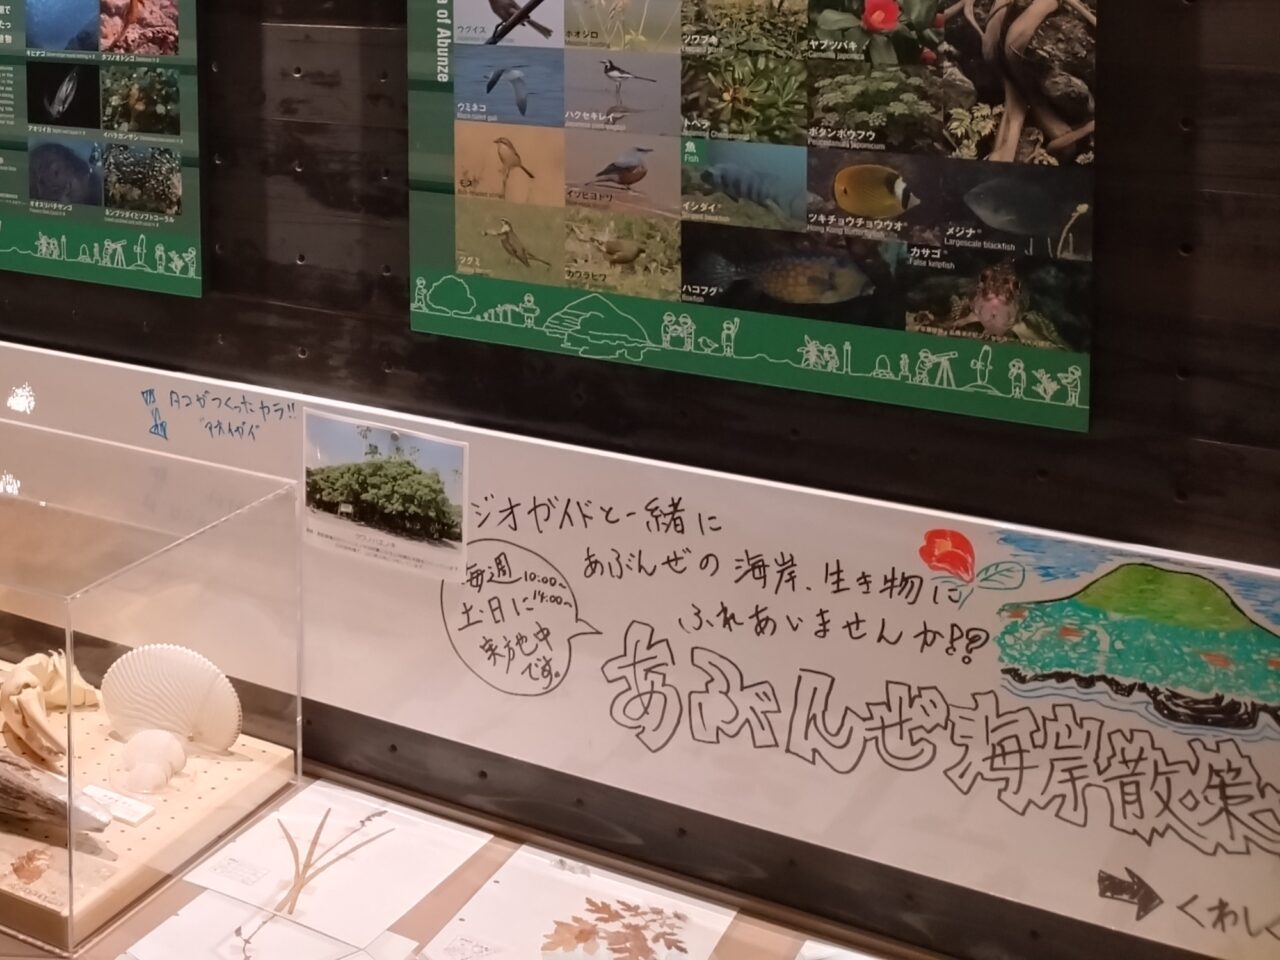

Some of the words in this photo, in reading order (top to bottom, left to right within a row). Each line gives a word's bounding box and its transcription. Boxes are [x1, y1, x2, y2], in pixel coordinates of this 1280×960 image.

[437, 10, 451, 25] of
[808, 40, 858, 51] ヤブツバキ
[437, 28, 451, 83] Abunze
[565, 110, 614, 123] ハクセキレイ
[808, 128, 876, 141] ボタンボウフウ
[685, 141, 696, 153] 魚
[684, 154, 699, 163] Fish
[808, 213, 903, 231] ツキチョウチョウウオ
[946, 227, 976, 237] メジナ
[910, 247, 941, 258] カサゴ
[682, 284, 718, 296] ハコフグ
[471, 496, 723, 535] ジオガイドと一緒に
[461, 552, 521, 593] 毎週
